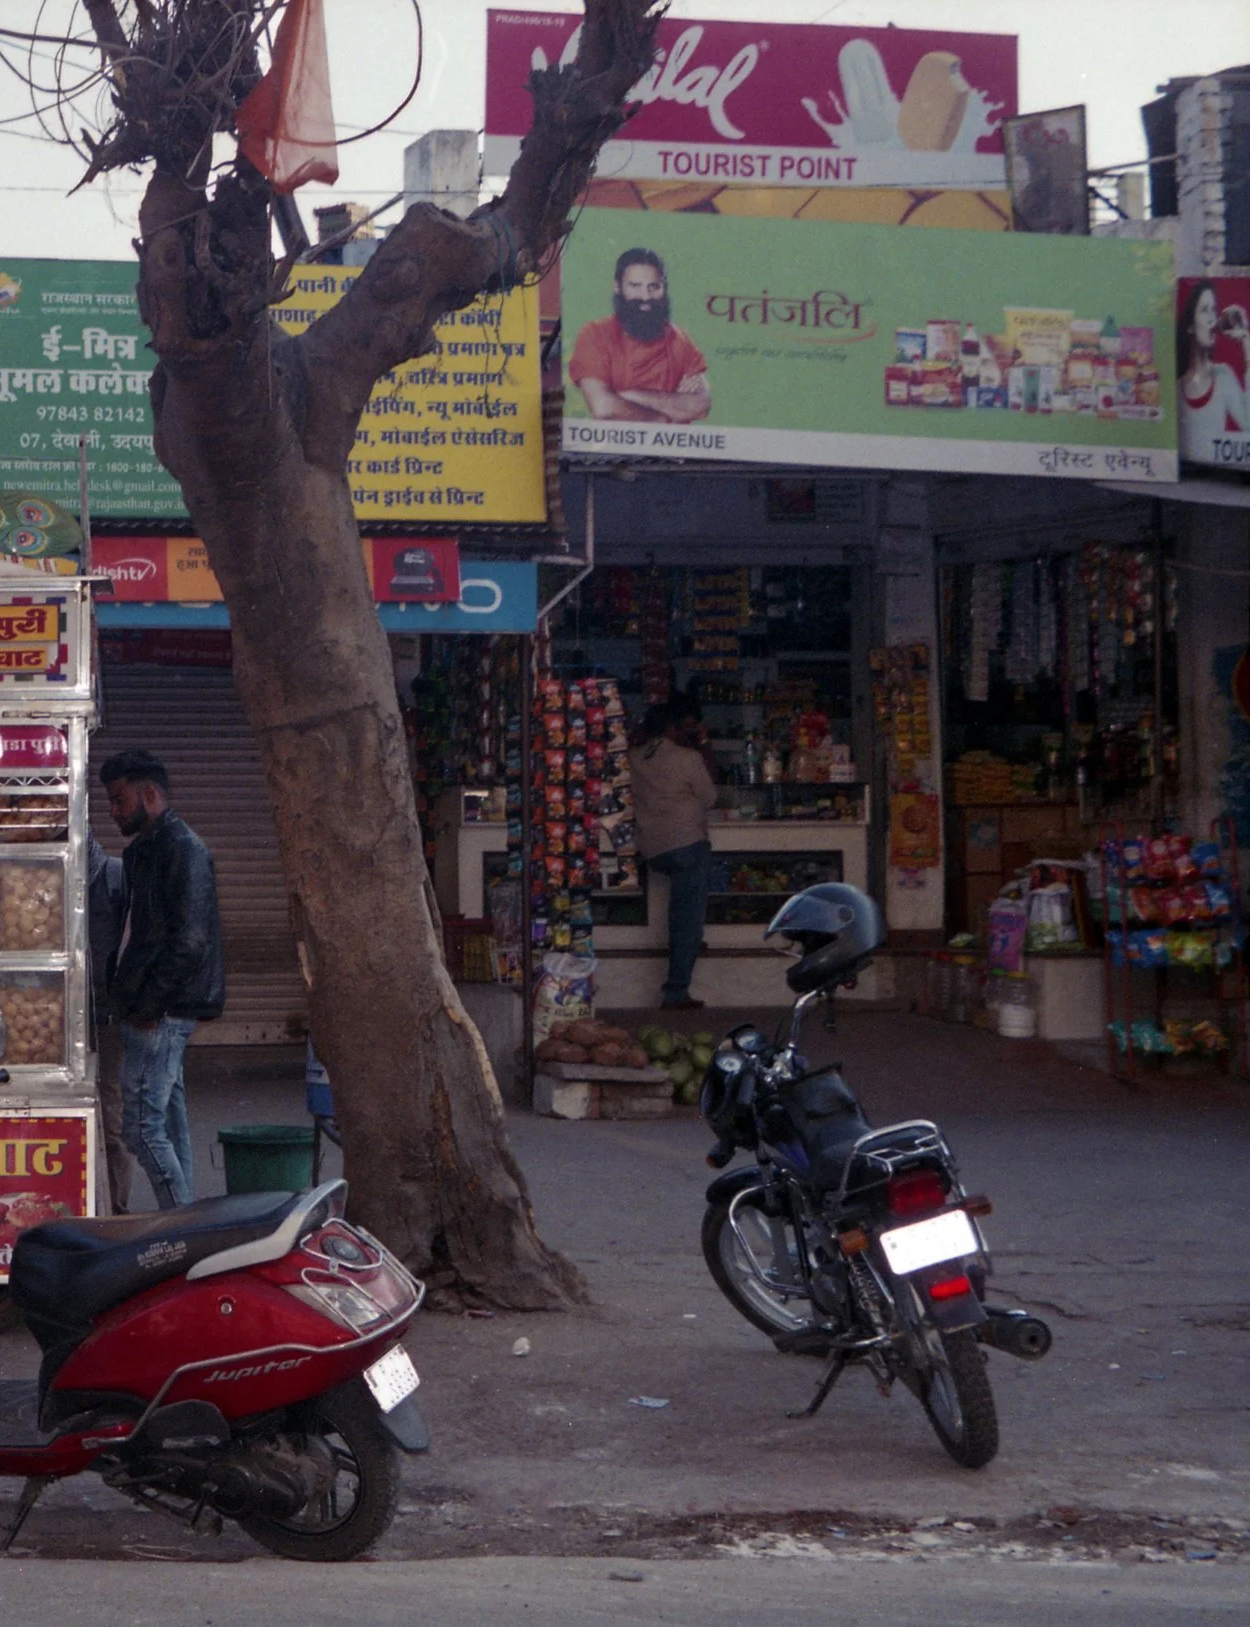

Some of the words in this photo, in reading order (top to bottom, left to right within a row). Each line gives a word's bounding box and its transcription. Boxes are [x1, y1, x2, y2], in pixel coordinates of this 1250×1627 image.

[658, 151, 771, 178] TOURIST
[779, 156, 857, 181] POINT
[705, 289, 863, 330] पतंजलि
[37, 405, 89, 422] 97843
[93, 406, 145, 422] 82142
[569, 427, 648, 446] TOURIST
[652, 431, 726, 449] AVENUE
[203, 1356, 312, 1383] Jupiter
